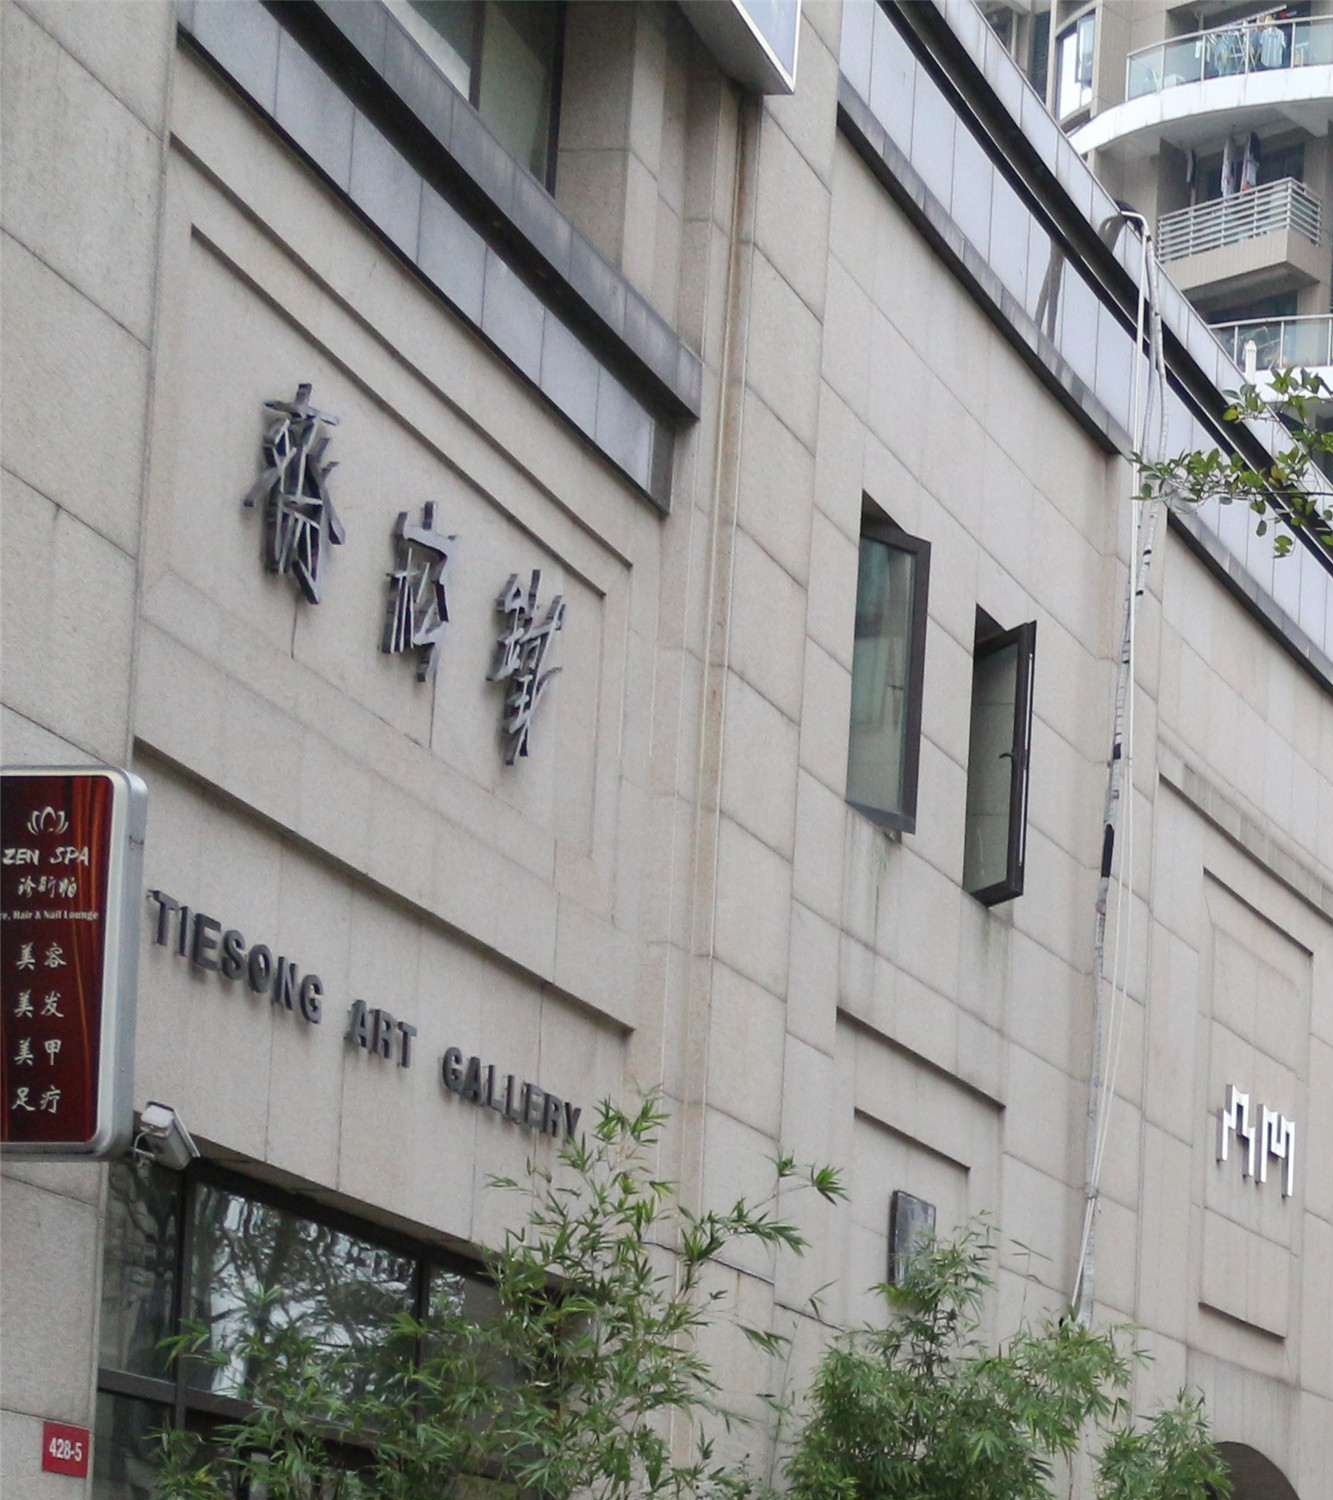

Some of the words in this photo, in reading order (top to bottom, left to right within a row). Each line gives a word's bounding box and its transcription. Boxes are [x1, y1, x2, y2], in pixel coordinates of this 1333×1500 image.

[2, 848, 39, 866] ZEN
[49, 847, 89, 866] SPA
[17, 942, 67, 971] 美容
[13, 989, 64, 1019] 美发
[148, 889, 324, 1024] TIESONG
[344, 999, 418, 1068] ART
[439, 1047, 582, 1143] GALLERY
[14, 1037, 62, 1066] 美甲
[12, 1085, 62, 1114] 足疗
[49, 1437, 83, 1462] 428-5
